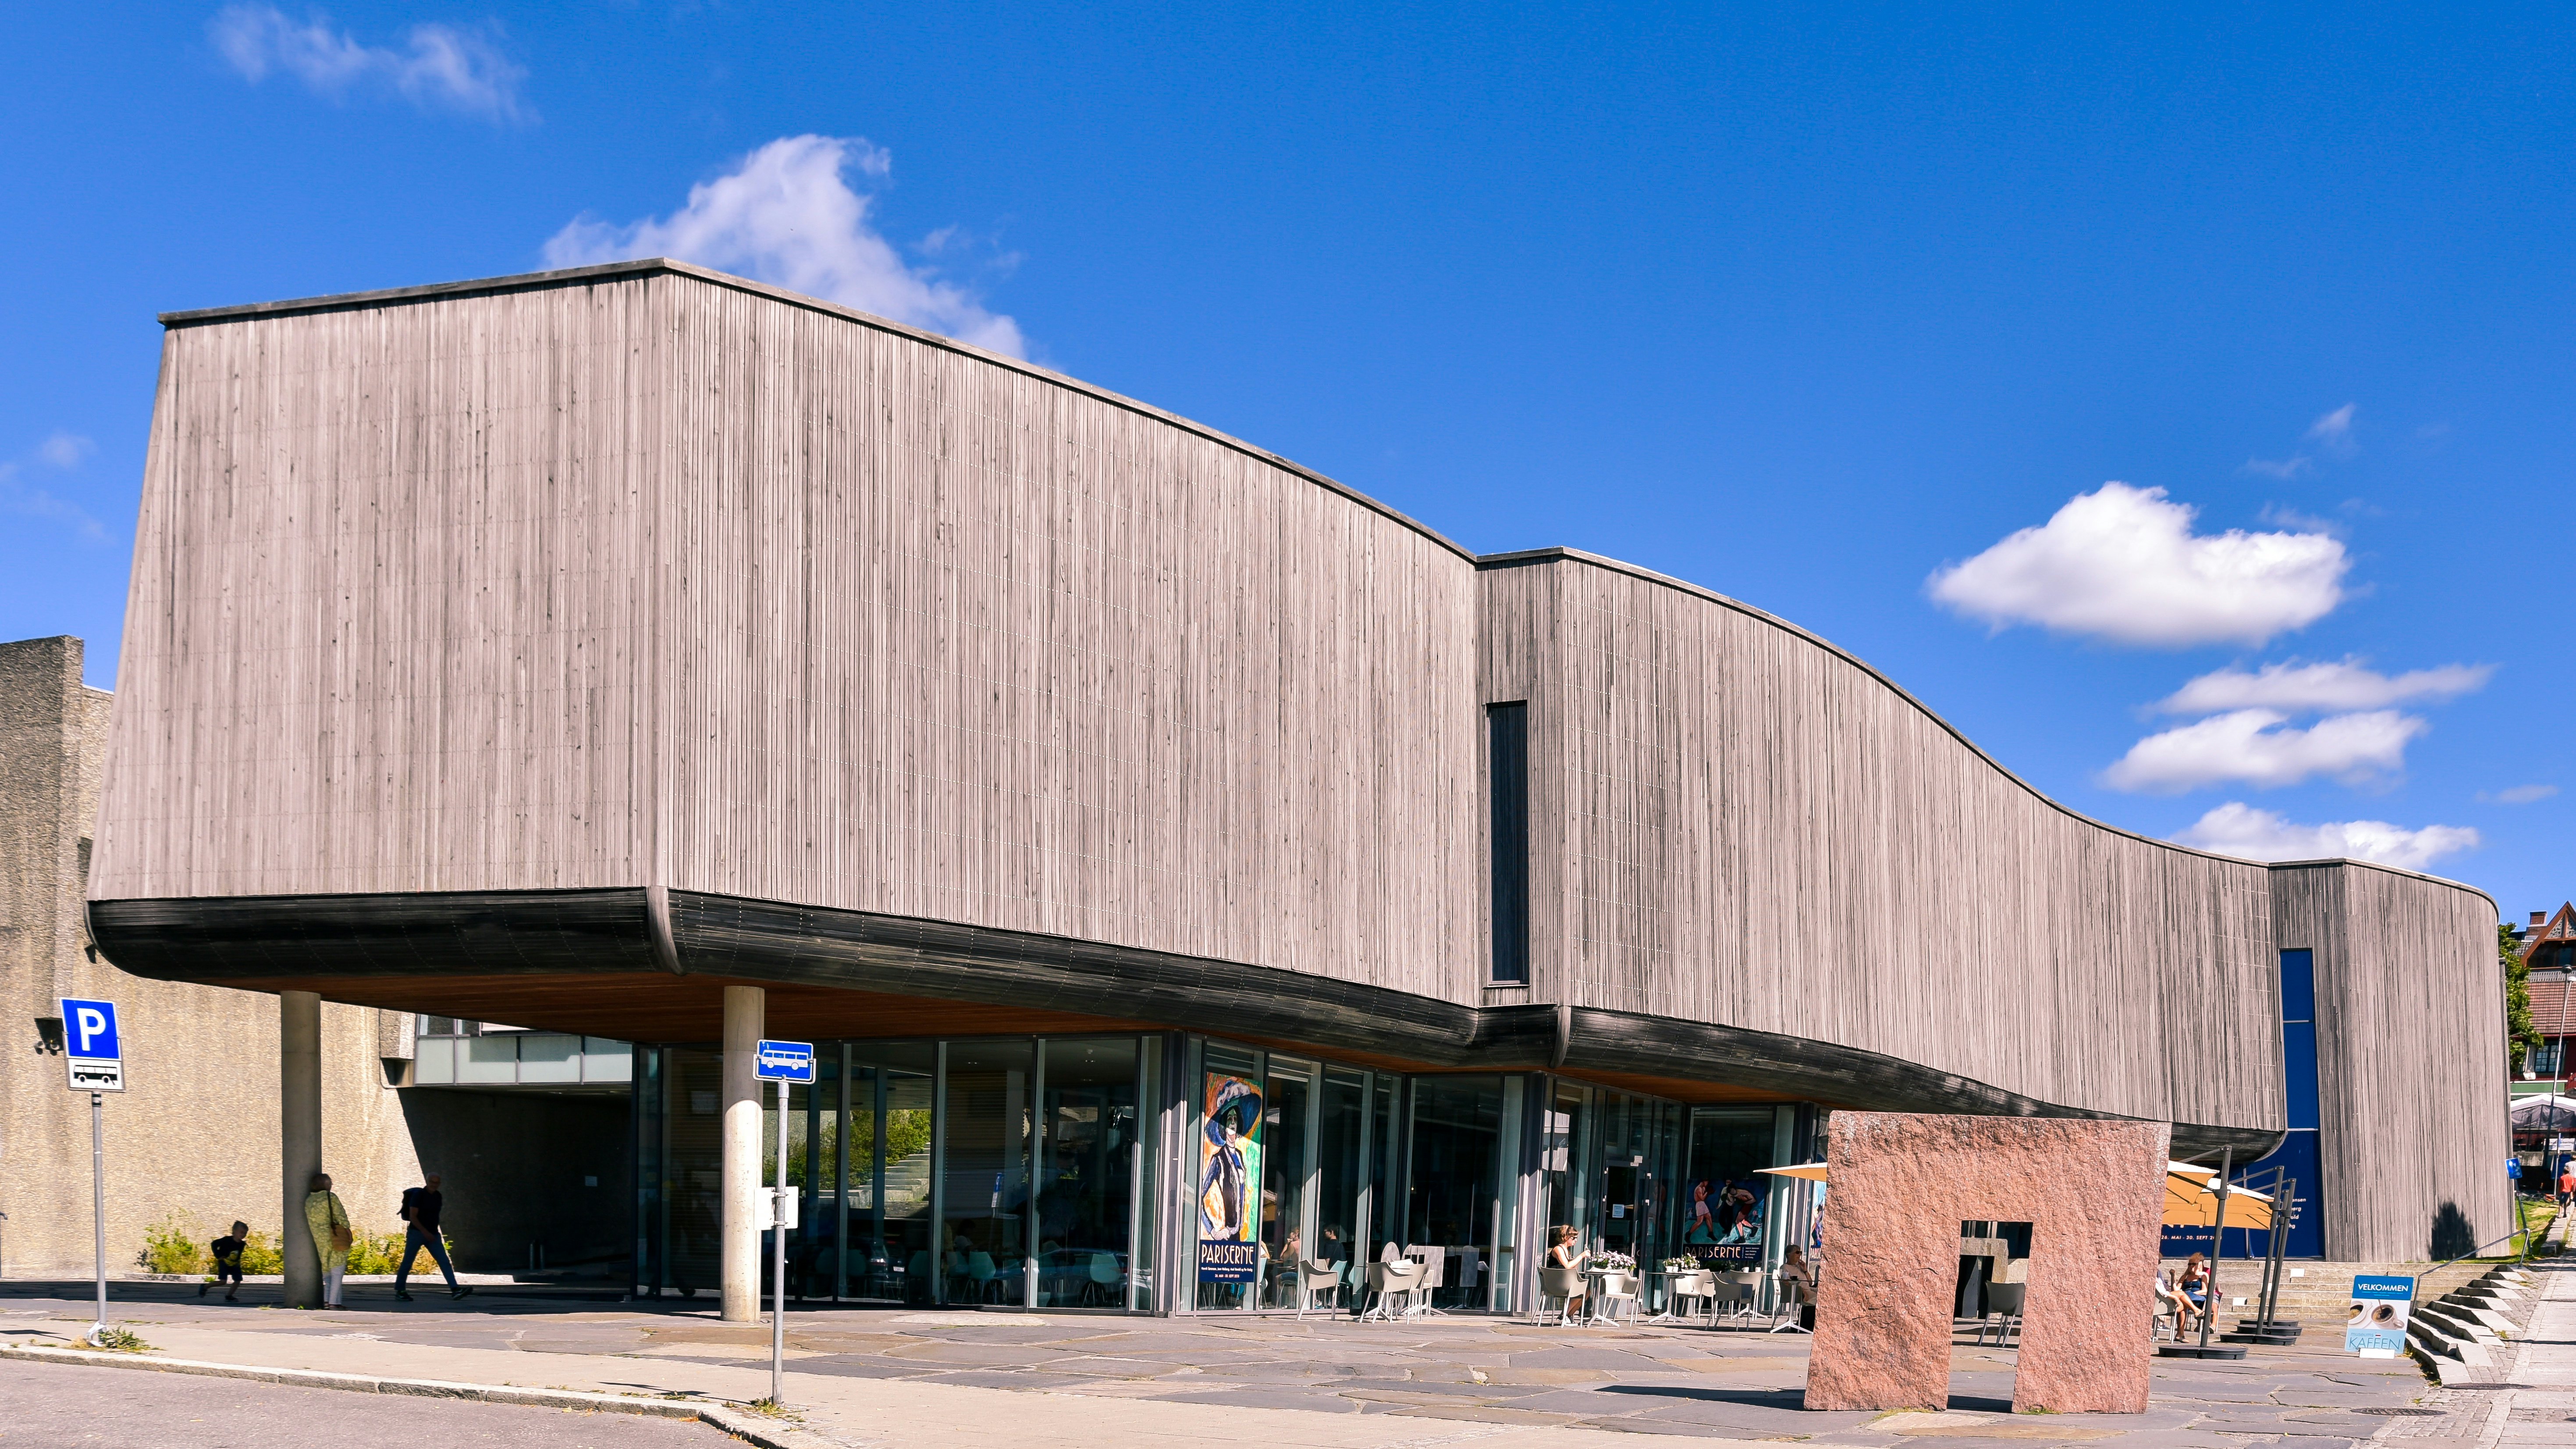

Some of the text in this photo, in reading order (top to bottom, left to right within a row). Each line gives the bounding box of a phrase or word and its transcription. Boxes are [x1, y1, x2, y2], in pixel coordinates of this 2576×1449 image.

[77, 1008, 106, 1051] P
[1201, 1244, 1254, 1264] PARISERNE
[1685, 1246, 1741, 1258] PARISERNE
[2358, 1283, 2409, 1292] VELKOMMEN
